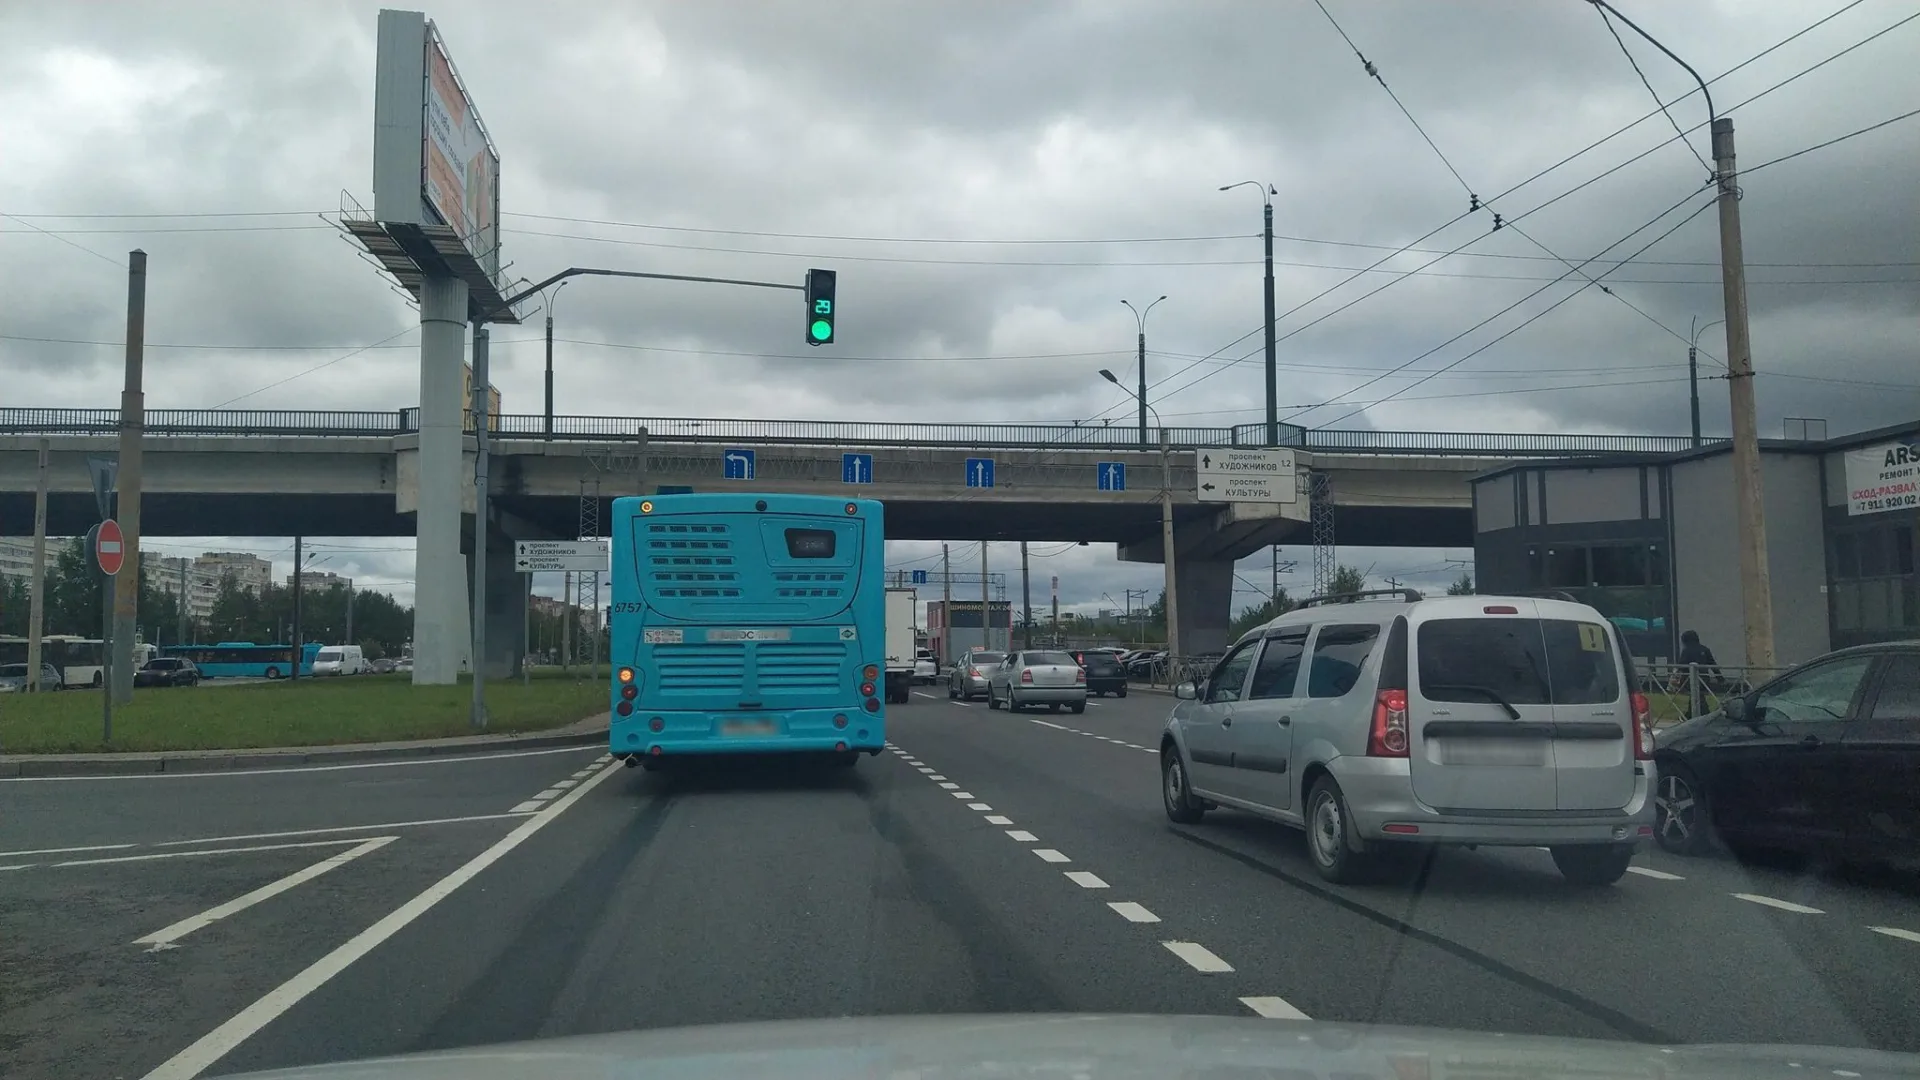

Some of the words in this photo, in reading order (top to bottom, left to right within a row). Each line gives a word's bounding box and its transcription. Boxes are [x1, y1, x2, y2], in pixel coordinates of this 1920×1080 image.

[1219, 462, 1277, 471] ХУДОЖНИКОВ
[1879, 468, 1913, 480] РЕМОНТ
[1225, 489, 1271, 497] КУЛЬТУРЫ
[1885, 496, 1903, 508] 920
[1904, 494, 1917, 505] 02
[614, 602, 642, 613] 6757
